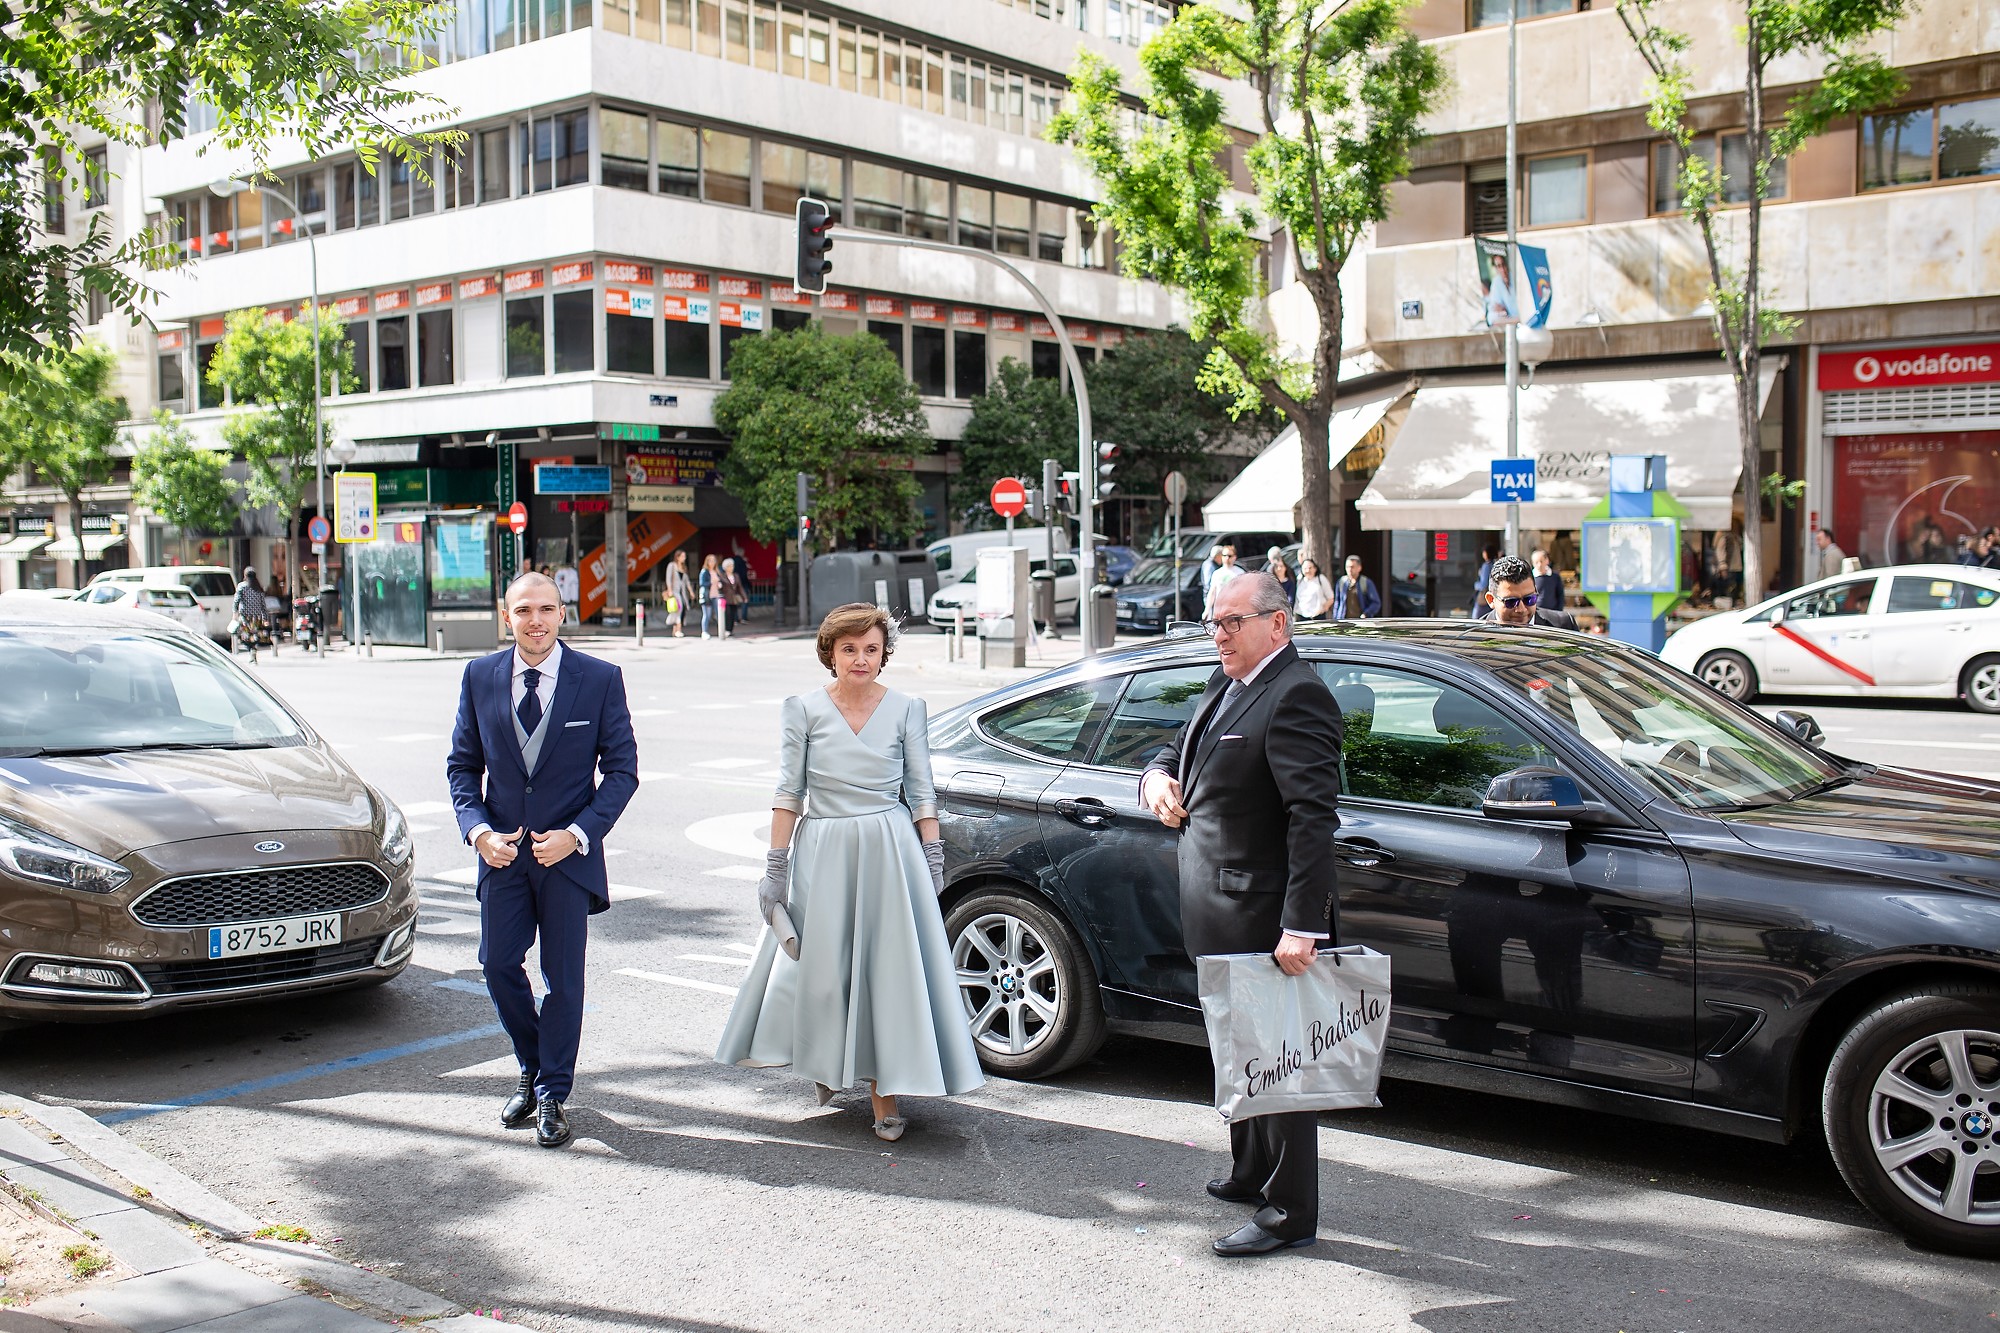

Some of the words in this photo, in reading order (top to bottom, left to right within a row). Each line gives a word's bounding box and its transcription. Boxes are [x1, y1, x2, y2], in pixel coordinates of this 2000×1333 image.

[1884, 353, 1993, 377] vodafone
[1537, 451, 1612, 464] TONIO
[1493, 473, 1534, 489] TAXI
[261, 842, 279, 850] Ford
[227, 925, 287, 951] 8752
[295, 918, 336, 943] JRK
[1245, 1040, 1302, 1099] Emilio
[1307, 989, 1385, 1061] Badiola
